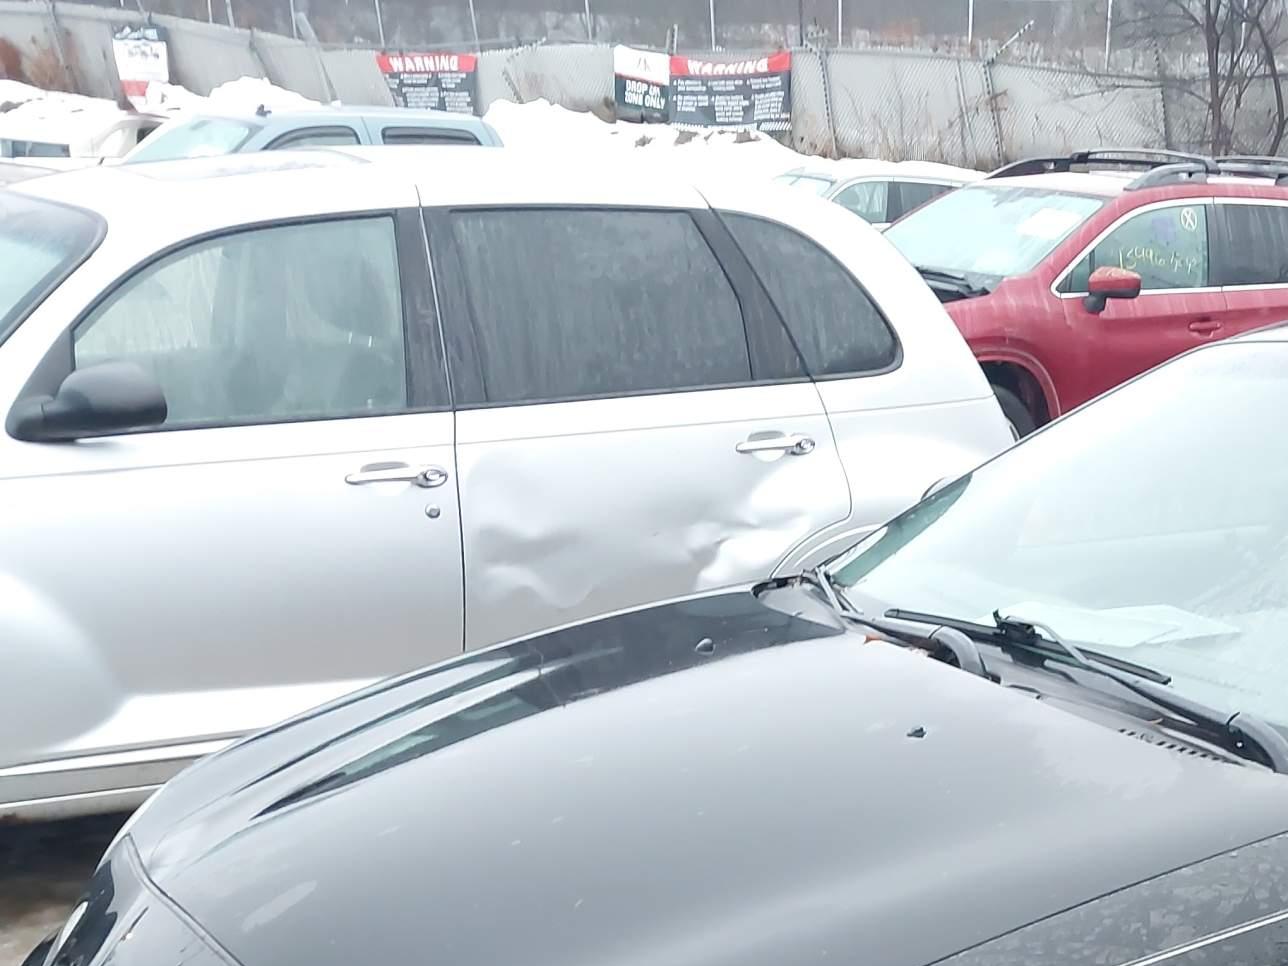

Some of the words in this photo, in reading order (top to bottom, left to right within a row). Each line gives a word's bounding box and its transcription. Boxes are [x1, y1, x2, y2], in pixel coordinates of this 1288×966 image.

[389, 55, 459, 72] WARNING
[687, 58, 769, 75] WARNING
[626, 80, 648, 95] DROP
[644, 95, 666, 110] ONLY
